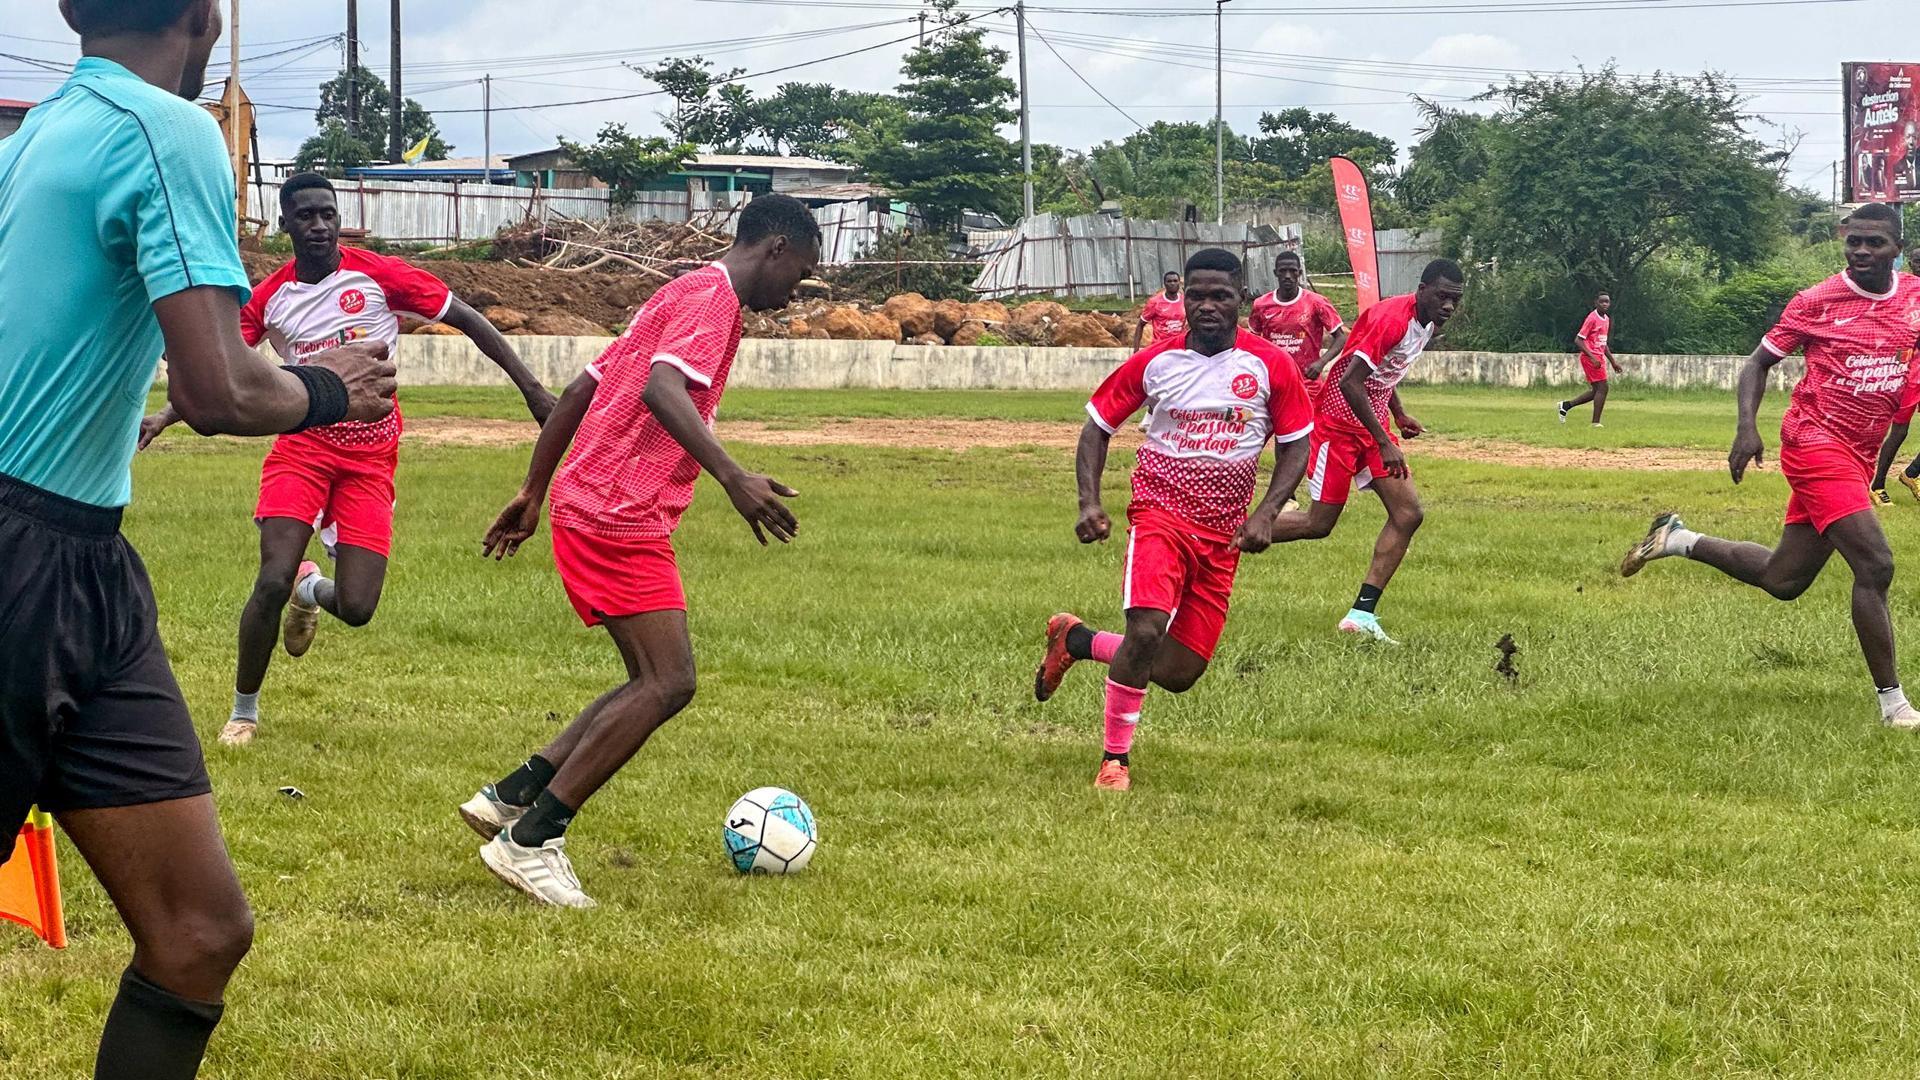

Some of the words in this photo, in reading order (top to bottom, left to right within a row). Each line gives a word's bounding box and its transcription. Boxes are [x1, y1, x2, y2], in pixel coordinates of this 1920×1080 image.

[1861, 90, 1899, 106] destruction
[1863, 103, 1899, 128] Autels
[1169, 408, 1225, 421] Célébrons
[1161, 430, 1171, 440] et
[1171, 433, 1180, 441] de
[1185, 420, 1245, 438] passion
